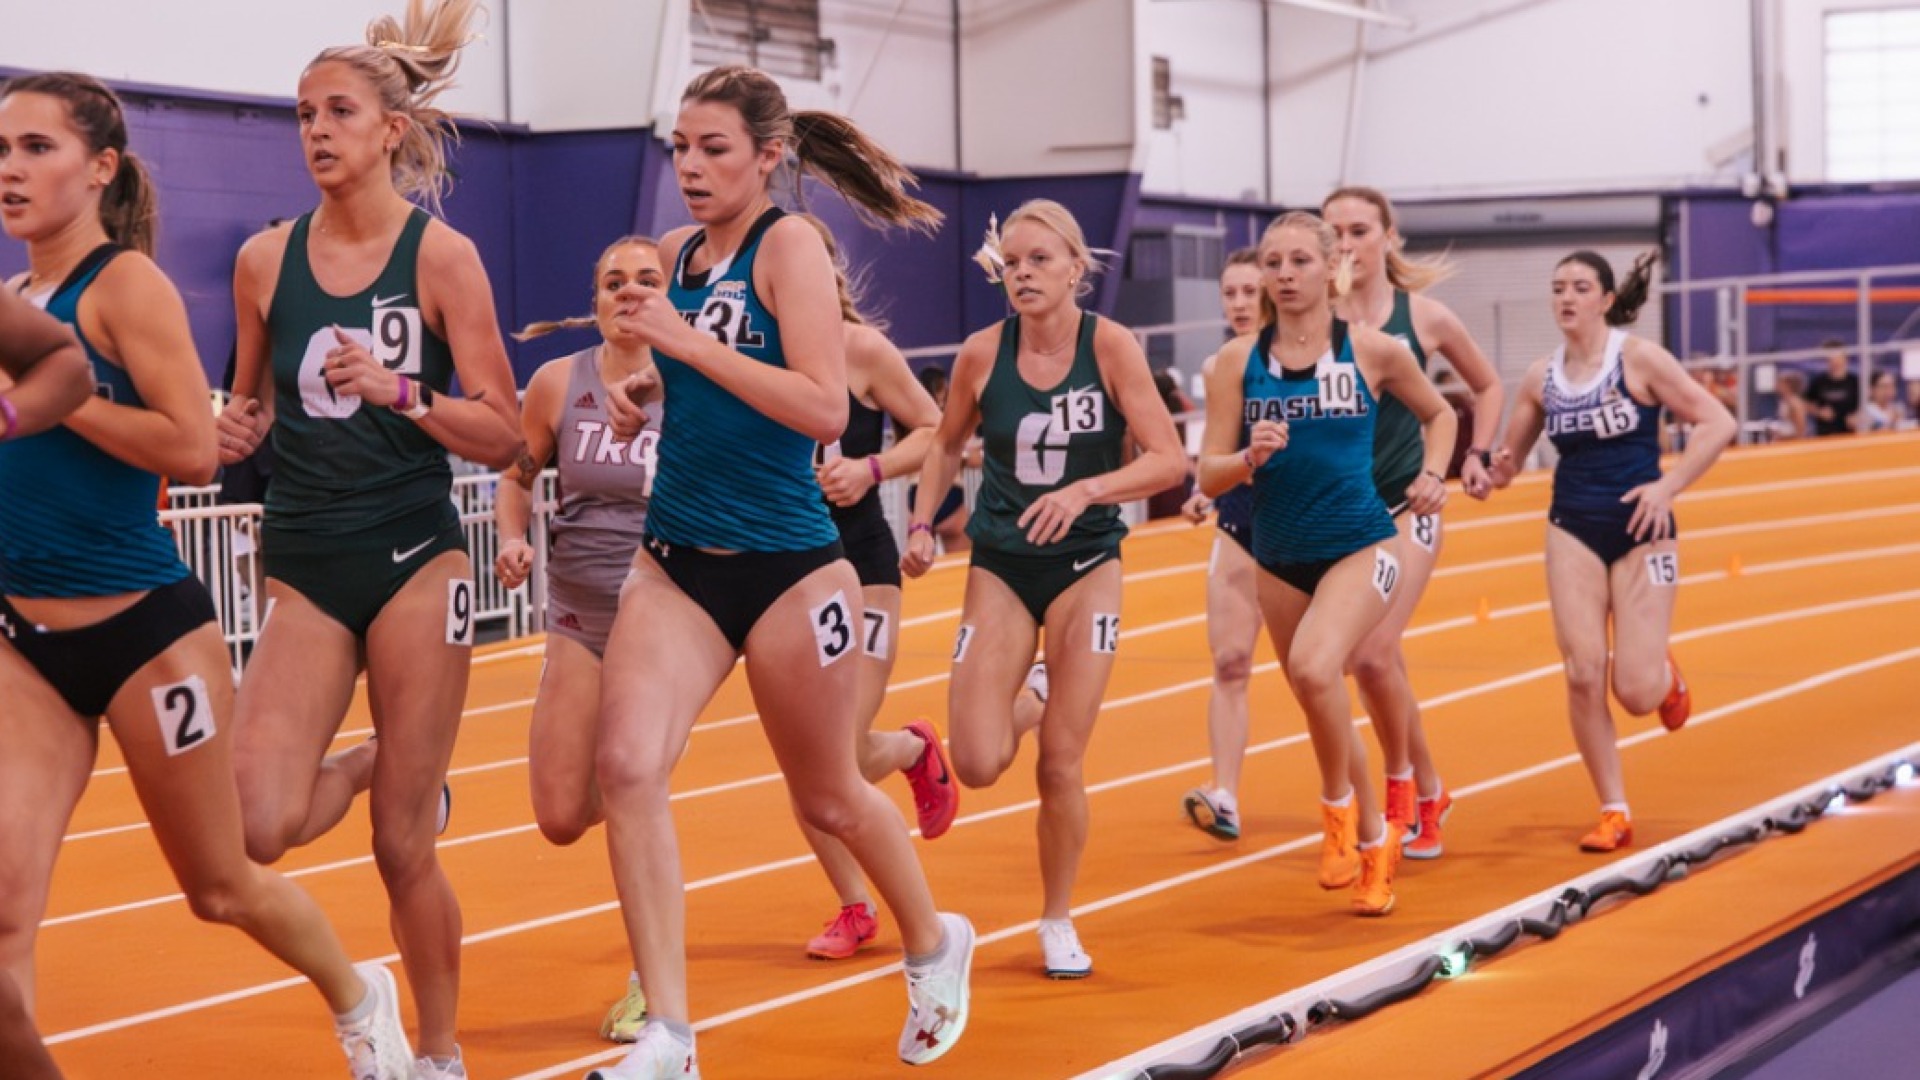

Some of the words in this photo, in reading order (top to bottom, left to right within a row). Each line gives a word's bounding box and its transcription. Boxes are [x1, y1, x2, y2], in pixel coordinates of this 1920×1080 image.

[381, 310, 409, 370] 9
[704, 301, 733, 345] 3
[1321, 372, 1353, 402] 10
[1056, 396, 1097, 431] 13
[1596, 404, 1630, 435] 15
[1415, 512, 1433, 546] 8
[1378, 558, 1396, 594] 10
[1650, 554, 1675, 583] 15
[454, 582, 470, 641] 9
[819, 601, 849, 657] 3
[863, 611, 884, 653] 7
[165, 686, 204, 749] 2
